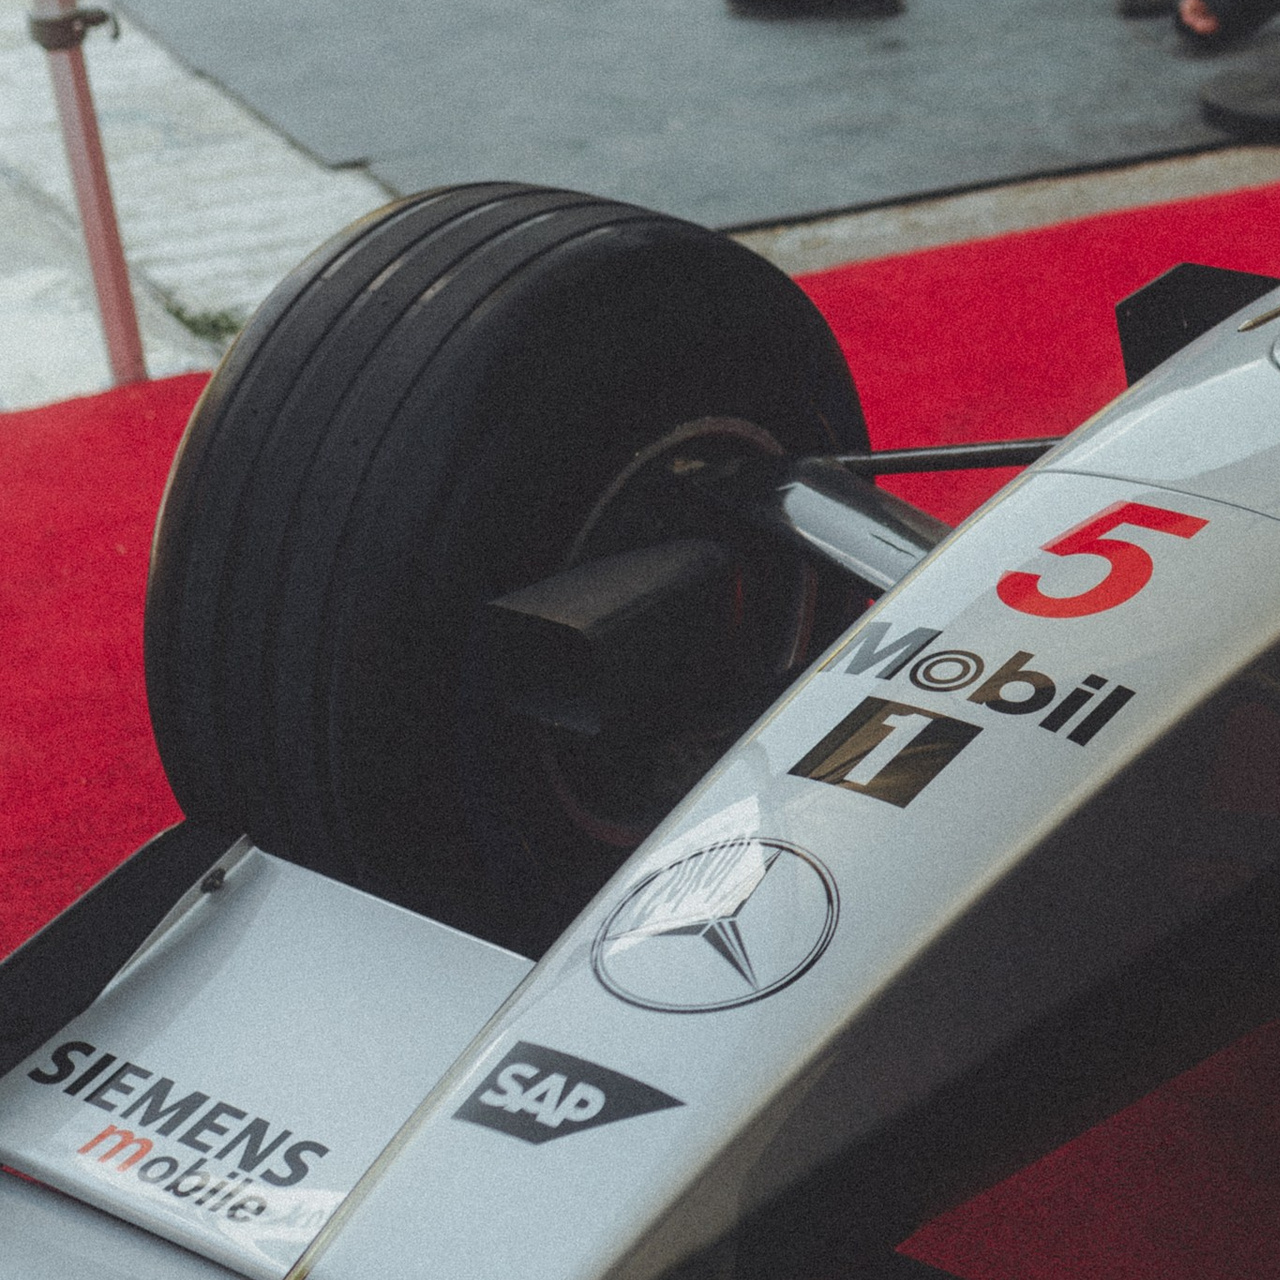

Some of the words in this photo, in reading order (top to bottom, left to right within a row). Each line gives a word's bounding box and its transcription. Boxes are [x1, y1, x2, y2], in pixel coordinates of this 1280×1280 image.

[996, 499, 1211, 619] 5
[817, 621, 1137, 748] Mobil
[843, 712, 934, 787] 1
[26, 1040, 331, 1187] SIEMENS
[479, 1062, 607, 1129] SAP
[76, 1123, 268, 1223] mobile
